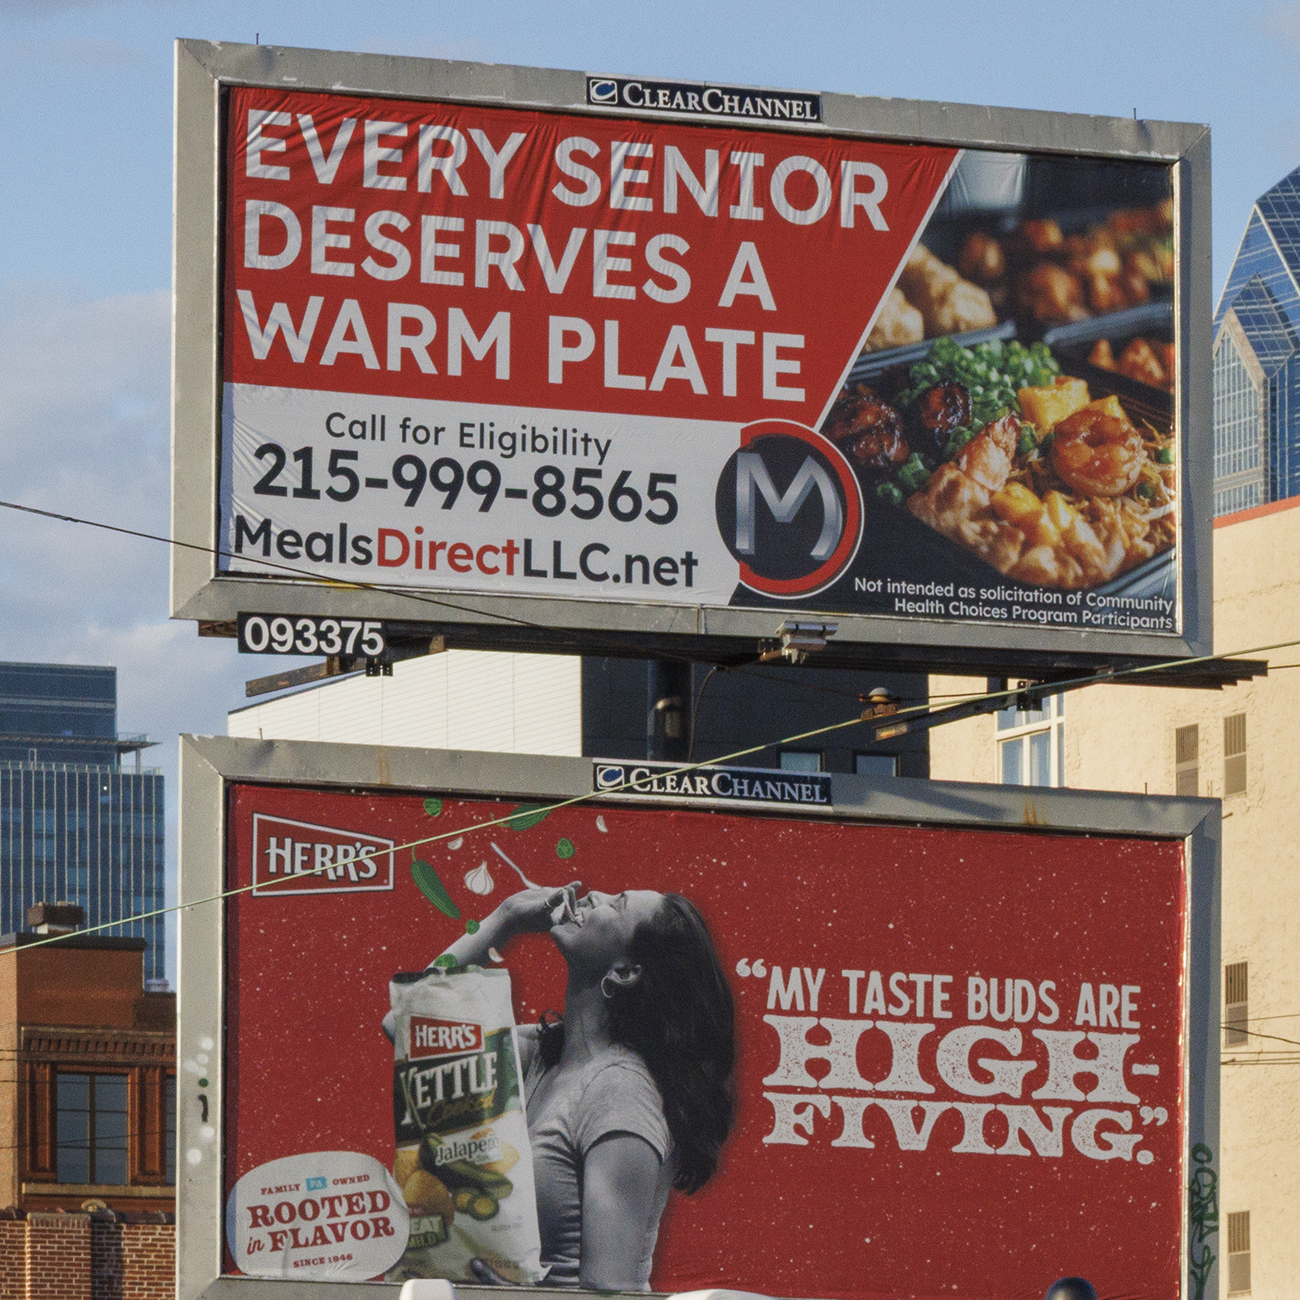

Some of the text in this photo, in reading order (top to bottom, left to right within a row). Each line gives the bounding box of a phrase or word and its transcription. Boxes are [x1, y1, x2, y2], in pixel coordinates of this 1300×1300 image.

[245, 109, 890, 231] EVERY SENIOR
[243, 199, 778, 311] DESERVES A
[236, 289, 806, 402] WARM PLATE
[324, 412, 613, 466] Call for Eligibility
[252, 442, 679, 525] 215-999-8565
[234, 515, 699, 589] MealsDirectLLC.net
[854, 577, 1174, 614] Not intended as solicitation of Community
[894, 598, 1173, 630] Health Choices Program Participants
[244, 617, 386, 657] 093375
[264, 836, 378, 882] HERR'S
[841, 969, 953, 1019] TASTE
[967, 976, 1060, 1024] BUDS
[1075, 982, 1141, 1029] ARE
[414, 1023, 477, 1050] HERR'S
[762, 1014, 1160, 1105] HIGH-
[400, 1051, 498, 1126] KETTLE
[247, 1190, 391, 1229] ROOTED
[261, 1183, 301, 1196] FAMILY
[332, 1174, 370, 1186] OWNED
[246, 1216, 395, 1256] in FLAVOR
[293, 1253, 353, 1269] SINCE 1946
